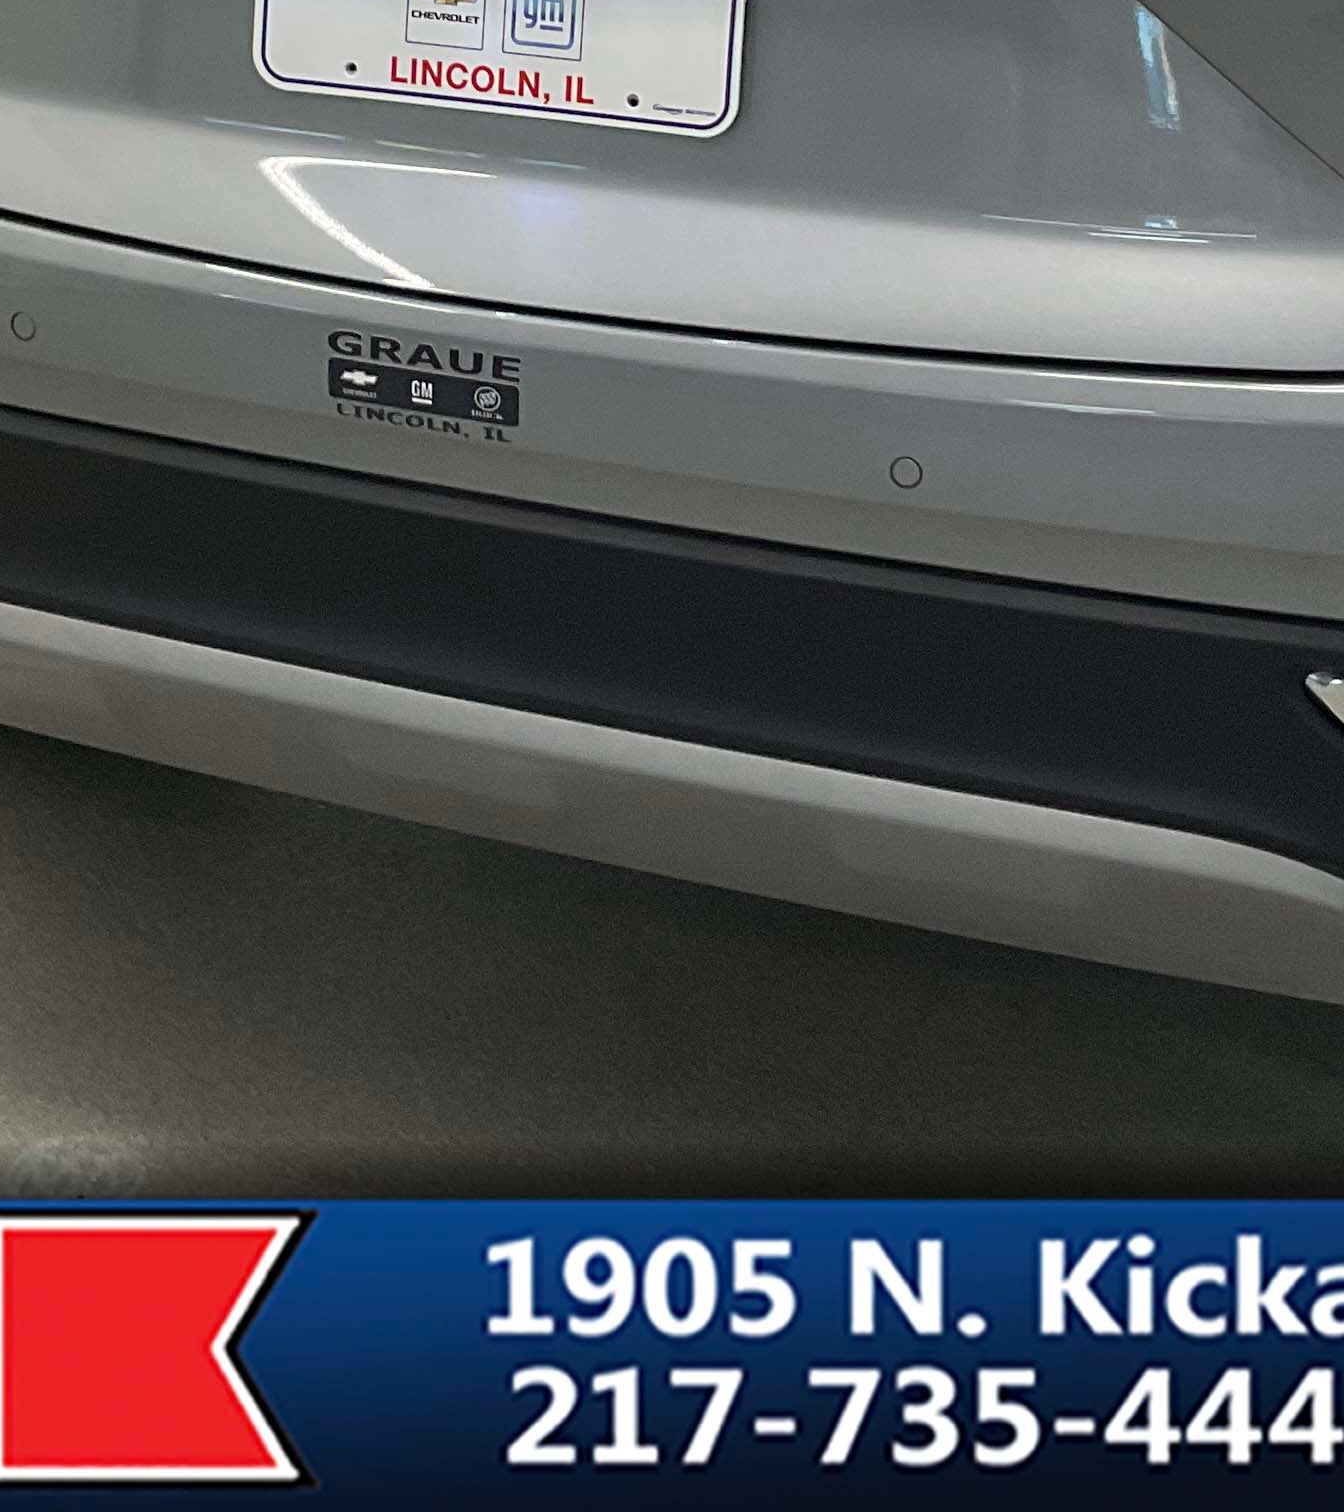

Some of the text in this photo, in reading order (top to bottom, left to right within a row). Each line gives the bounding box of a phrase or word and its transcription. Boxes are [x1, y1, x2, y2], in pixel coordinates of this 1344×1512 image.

[411, 9, 480, 25] CHEVROLET
[389, 55, 594, 105] LINCOLN, IL
[328, 331, 521, 383] GRAUE
[336, 402, 470, 439] LINCOLN,
[482, 425, 512, 444] IL
